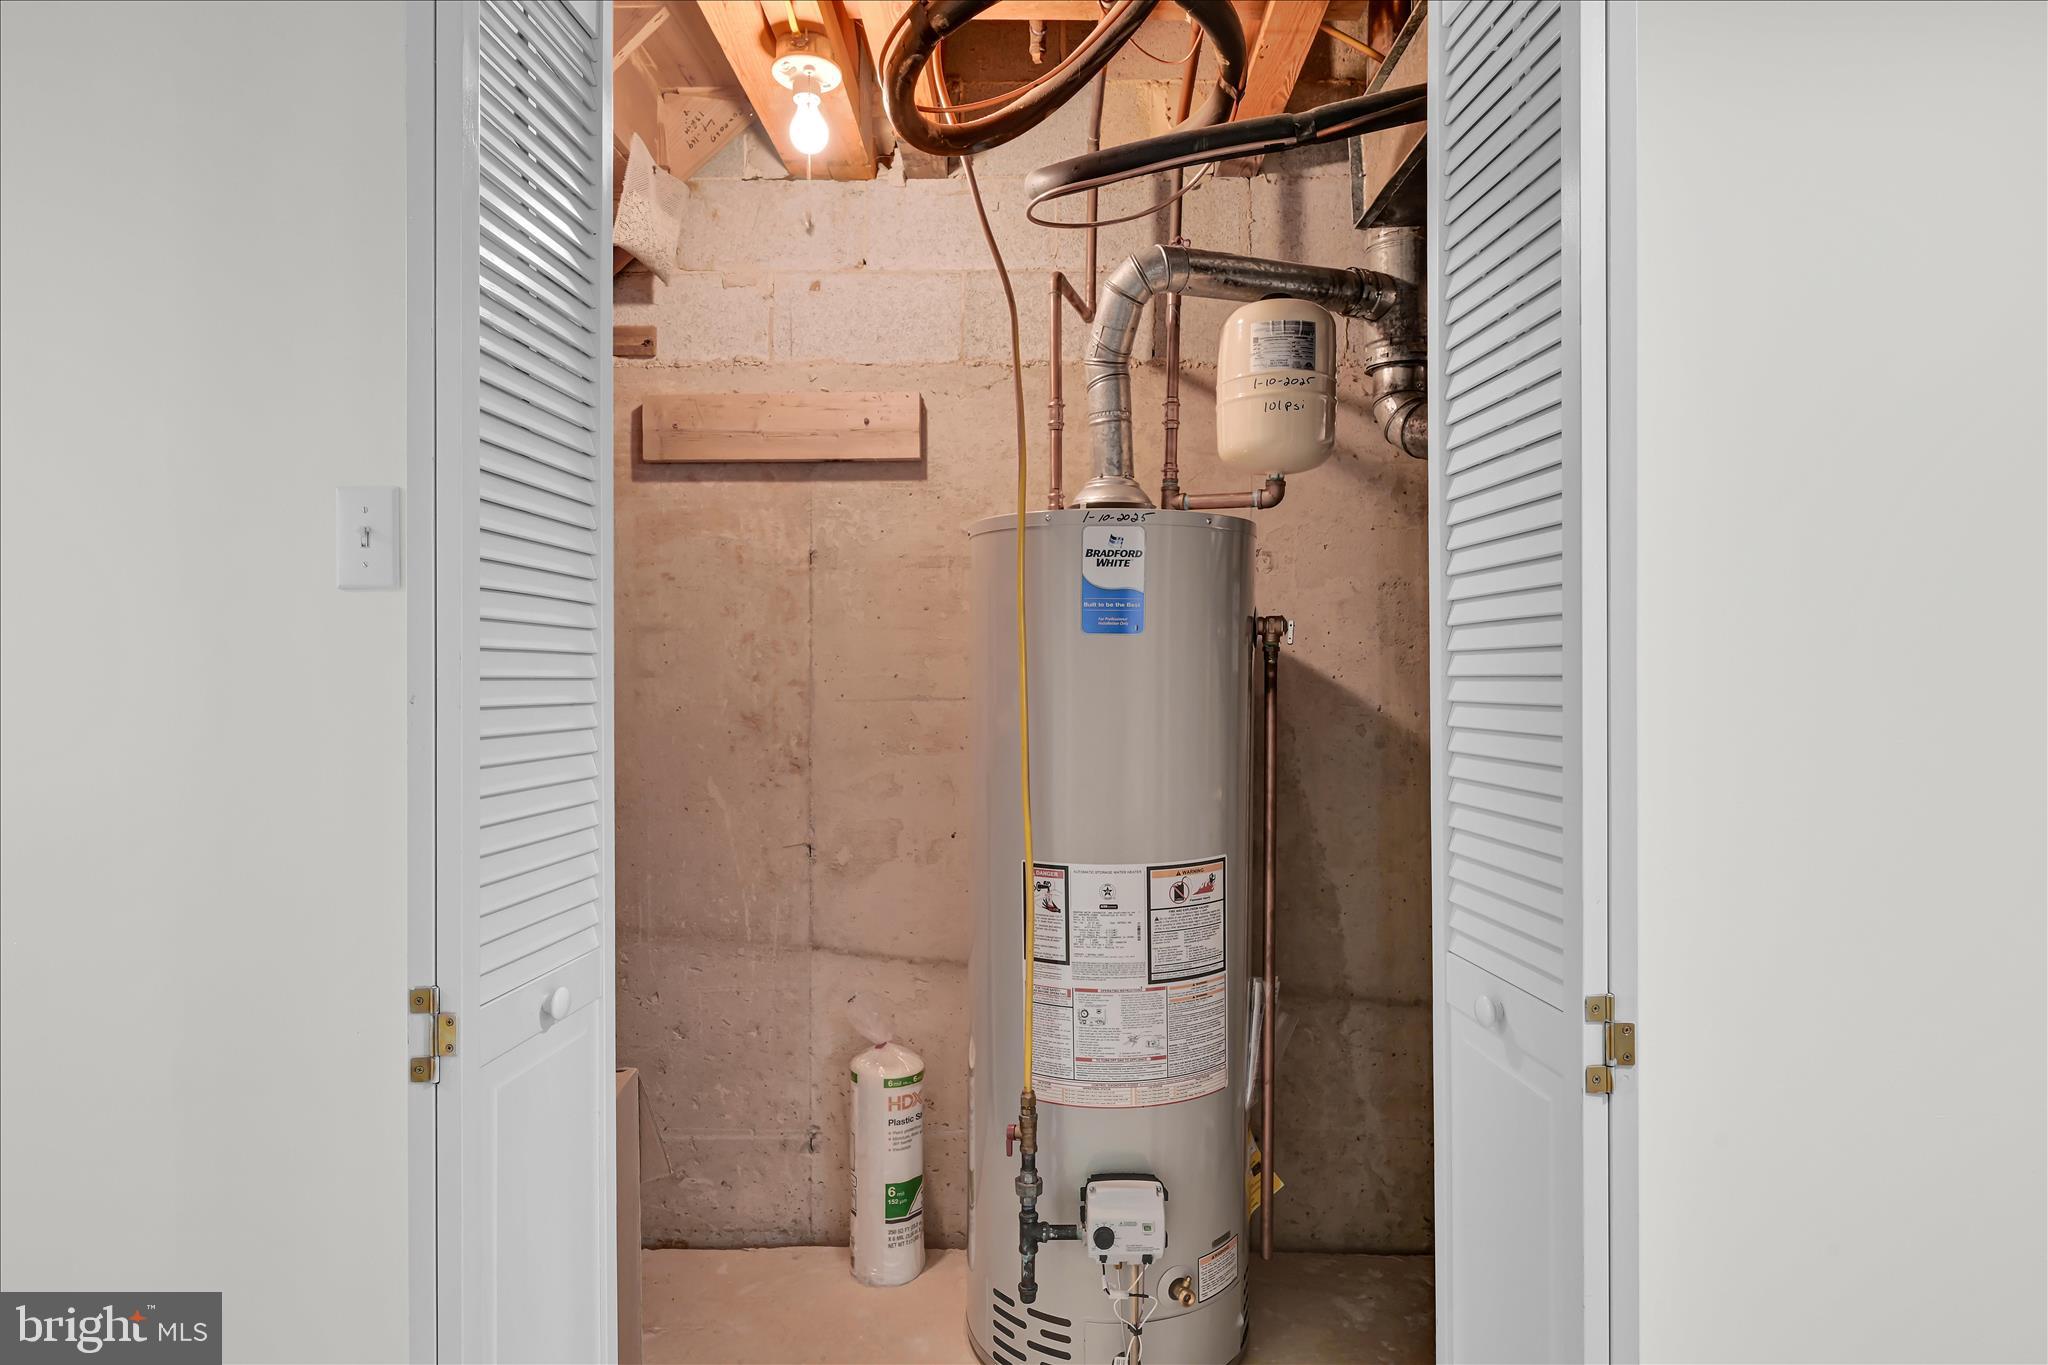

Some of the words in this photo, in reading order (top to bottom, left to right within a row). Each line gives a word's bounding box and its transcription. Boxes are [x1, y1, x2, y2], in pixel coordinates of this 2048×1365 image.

[1253, 377, 1316, 389] 1-10-2025
[1082, 511, 1156, 523] 1-10-2025
[1085, 549, 1143, 558] BRADFORD
[1096, 559, 1131, 568] WHITE
[1035, 870, 1059, 878] DANGER
[1182, 867, 1205, 876] WARNING
[888, 1091, 923, 1112] HDX
[888, 1115, 914, 1127] Plastic
[887, 1186, 896, 1198] 6
